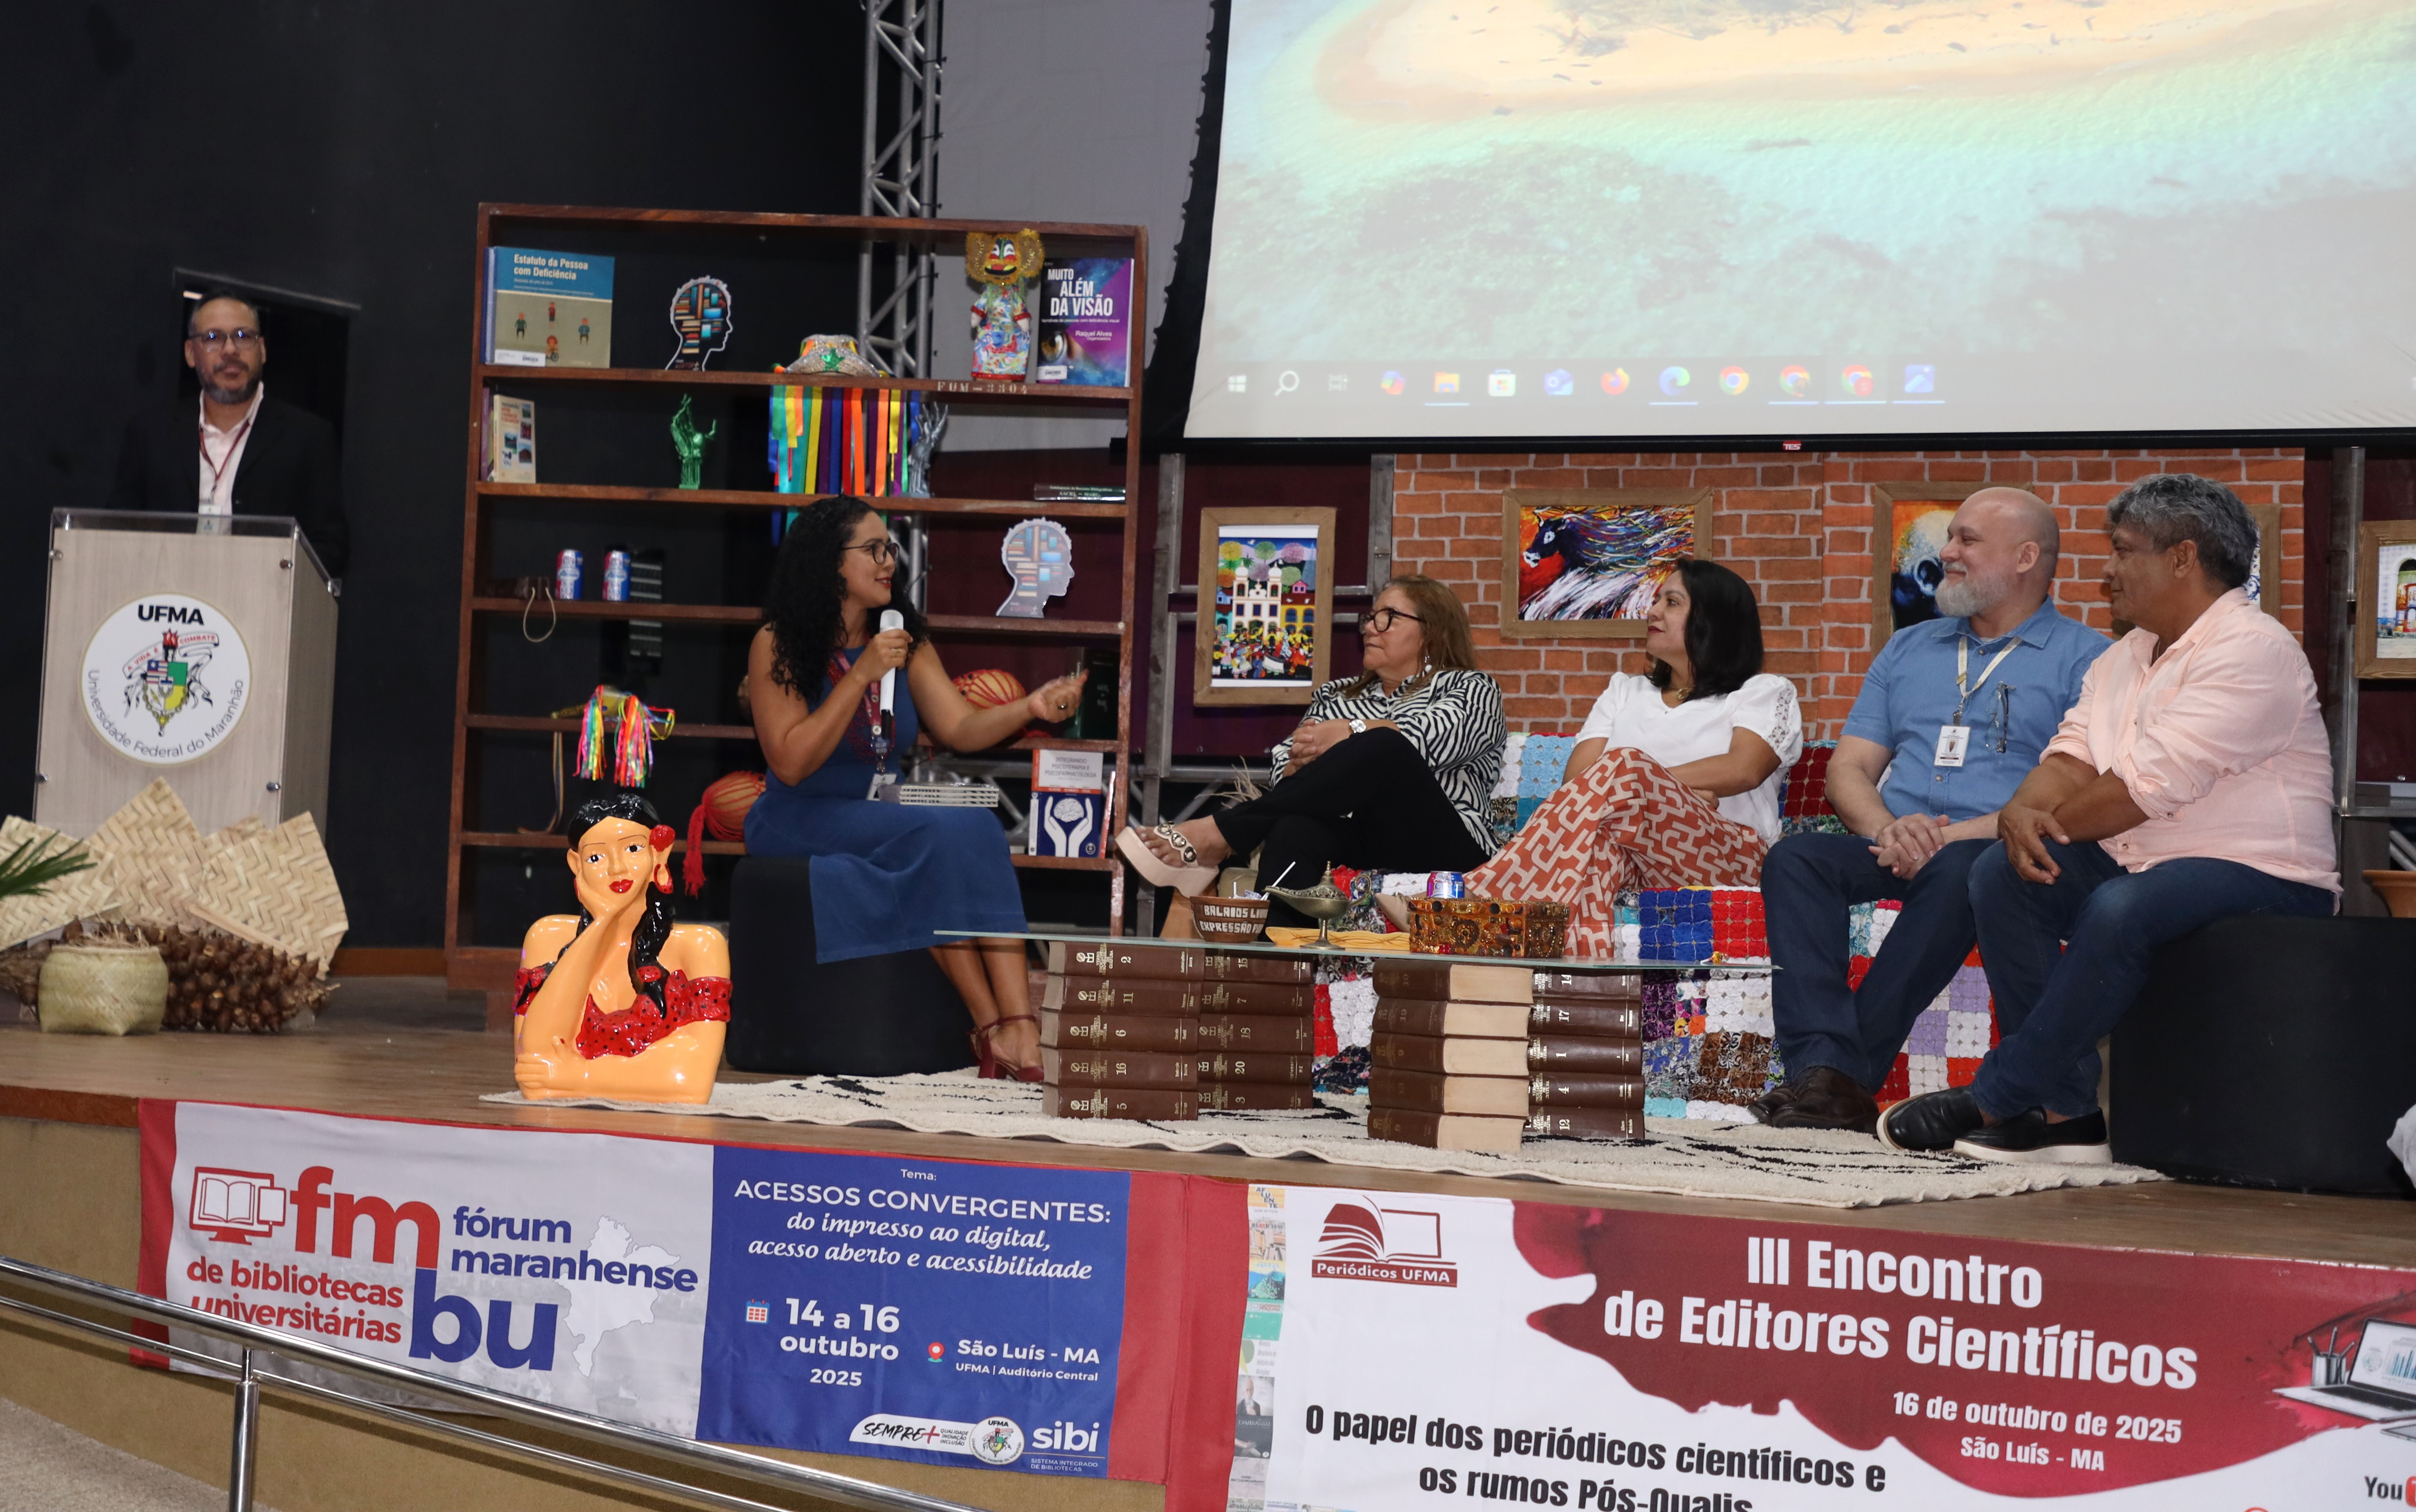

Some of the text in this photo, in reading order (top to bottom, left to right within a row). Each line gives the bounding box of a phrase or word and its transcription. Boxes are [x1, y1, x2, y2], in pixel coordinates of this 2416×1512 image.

[514, 254, 588, 270] Estatuto da Pessoa
[514, 267, 576, 280] com Deficiência
[1047, 268, 1074, 280] MUITO
[1060, 278, 1094, 297] ALÉM
[1050, 294, 1113, 317] DA VISÃO
[138, 604, 204, 626] UFMA
[133, 653, 151, 665] VIDA
[179, 635, 217, 645] COMBATE
[88, 669, 243, 758] Universidade Federal do Maranhão
[1199, 921, 1252, 934] EXPRESSÃO
[1238, 958, 1248, 969] 15
[1561, 974, 1572, 985] 14
[1123, 992, 1134, 1004] 11
[1558, 1010, 1570, 1022] 17
[1240, 1027, 1251, 1040] 18
[1115, 1063, 1127, 1075] 16
[1235, 1061, 1245, 1075] 20
[1558, 1086, 1569, 1095] 4
[1559, 1118, 1570, 1131] 12
[900, 1168, 937, 1182] Tema:
[734, 1179, 1111, 1224] ACESSOS CONVERGENTES:
[289, 1166, 441, 1269] fm
[453, 1205, 572, 1244] fórum
[787, 1212, 1051, 1251] do impresso ao digital,
[451, 1246, 699, 1293] maranhense
[748, 1239, 1092, 1280] acesso aberto e acessibilidade
[1747, 1236, 2043, 1308] III Encontro
[186, 1256, 404, 1309] de bibliotecas
[1317, 1263, 1450, 1283] Periódicos UFMA
[191, 1294, 402, 1344] universitárias
[408, 1268, 559, 1372] bu
[786, 1298, 900, 1333] 14 a 16
[780, 1335, 899, 1361] outubro
[957, 1338, 997, 1357] São
[1002, 1343, 1046, 1361] Luís
[1064, 1347, 1100, 1364] MA
[1603, 1290, 2198, 1390] de Editores Científicos
[810, 1368, 862, 1387] 2025
[955, 1363, 990, 1374] UFMA
[998, 1366, 1053, 1380] Auditório
[1055, 1370, 1098, 1381] Central
[1892, 1391, 2183, 1444] 16 de outubro de 2025
[1032, 1421, 1100, 1452] sibi
[1306, 1405, 1886, 1493] O papel dos periódicos científicos e
[1960, 1436, 2000, 1461] São
[2005, 1441, 2050, 1467] Luís
[2070, 1448, 2105, 1471] MA
[1419, 1467, 1457, 1493] os
[1467, 1470, 1568, 1508] rumos
